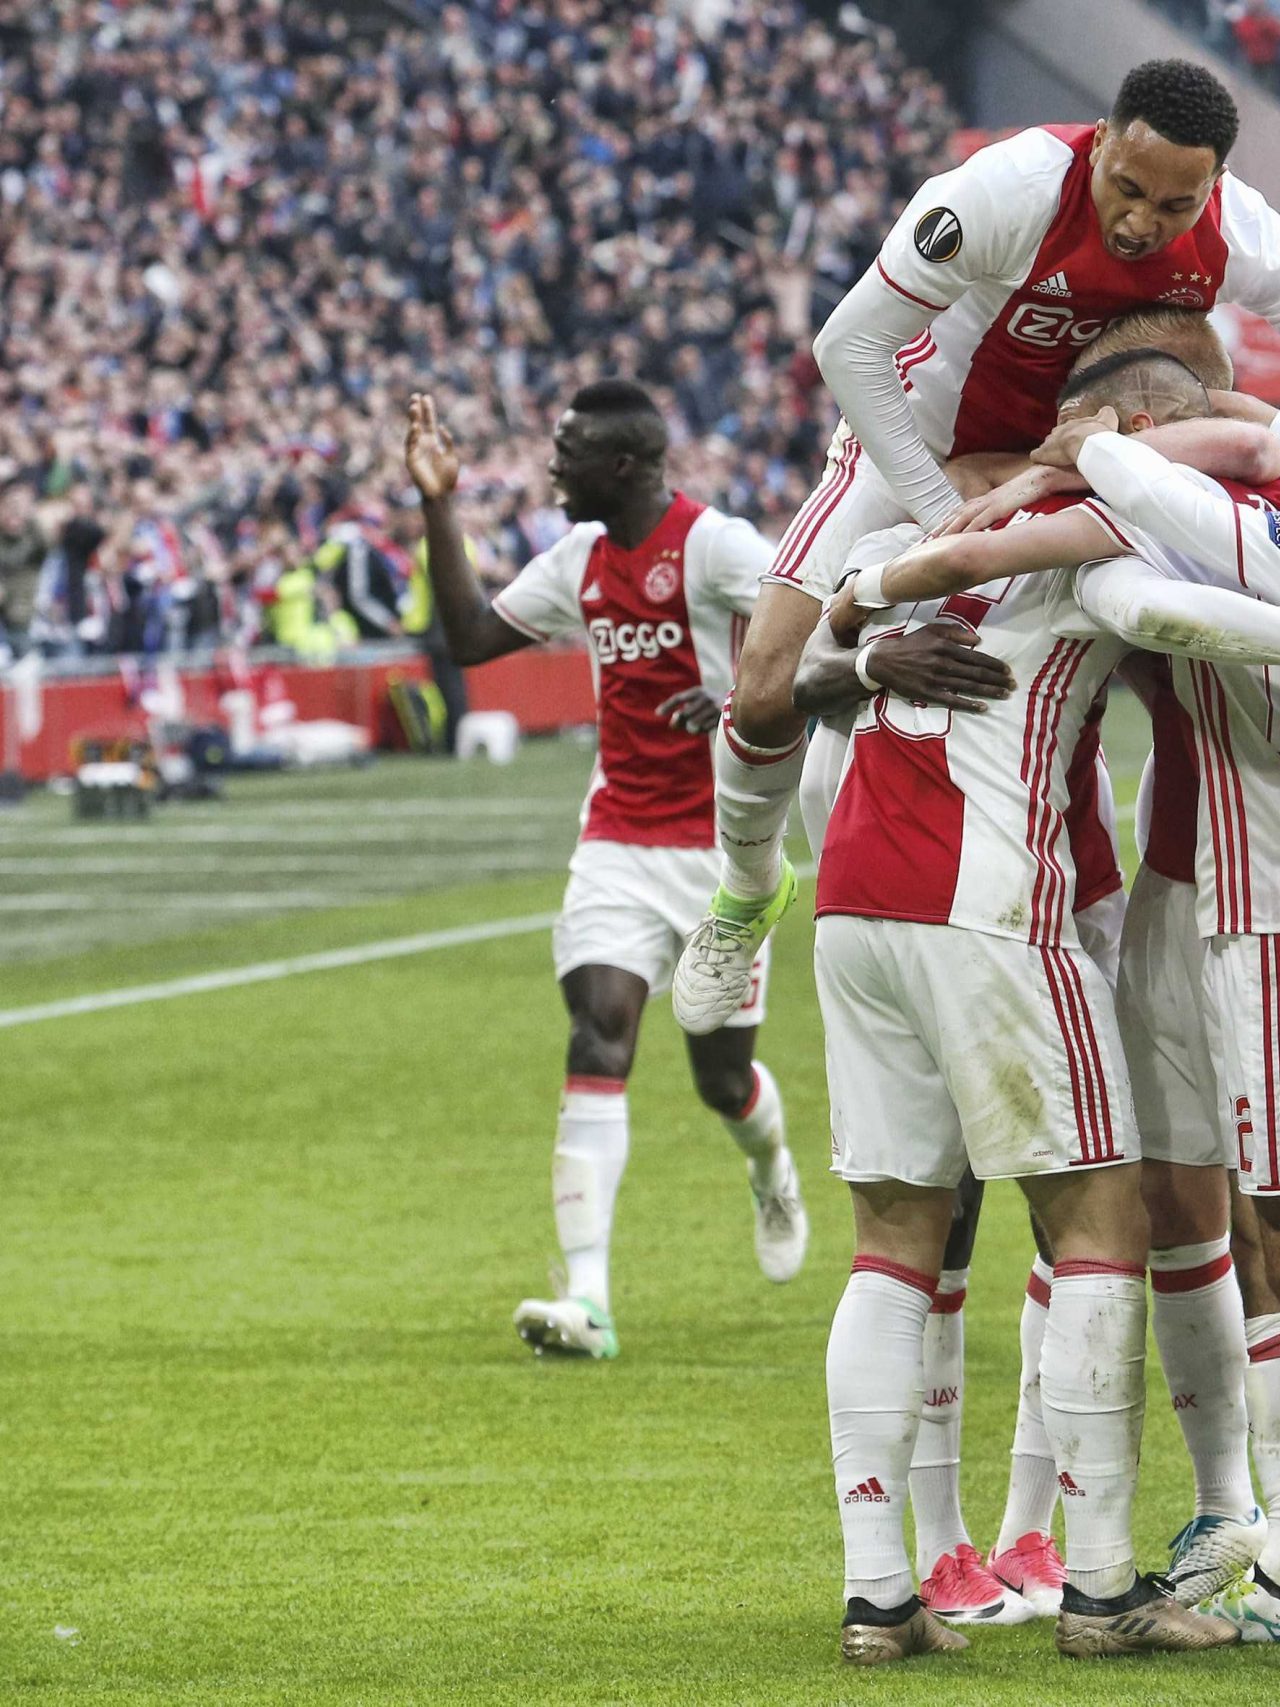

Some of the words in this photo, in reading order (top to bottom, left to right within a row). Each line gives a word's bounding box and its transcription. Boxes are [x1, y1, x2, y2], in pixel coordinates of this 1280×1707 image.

[1032, 283, 1072, 298] adidas
[923, 1385, 959, 1407] JAX
[1172, 1393, 1198, 1410] AX
[844, 1493, 891, 1504] adidas
